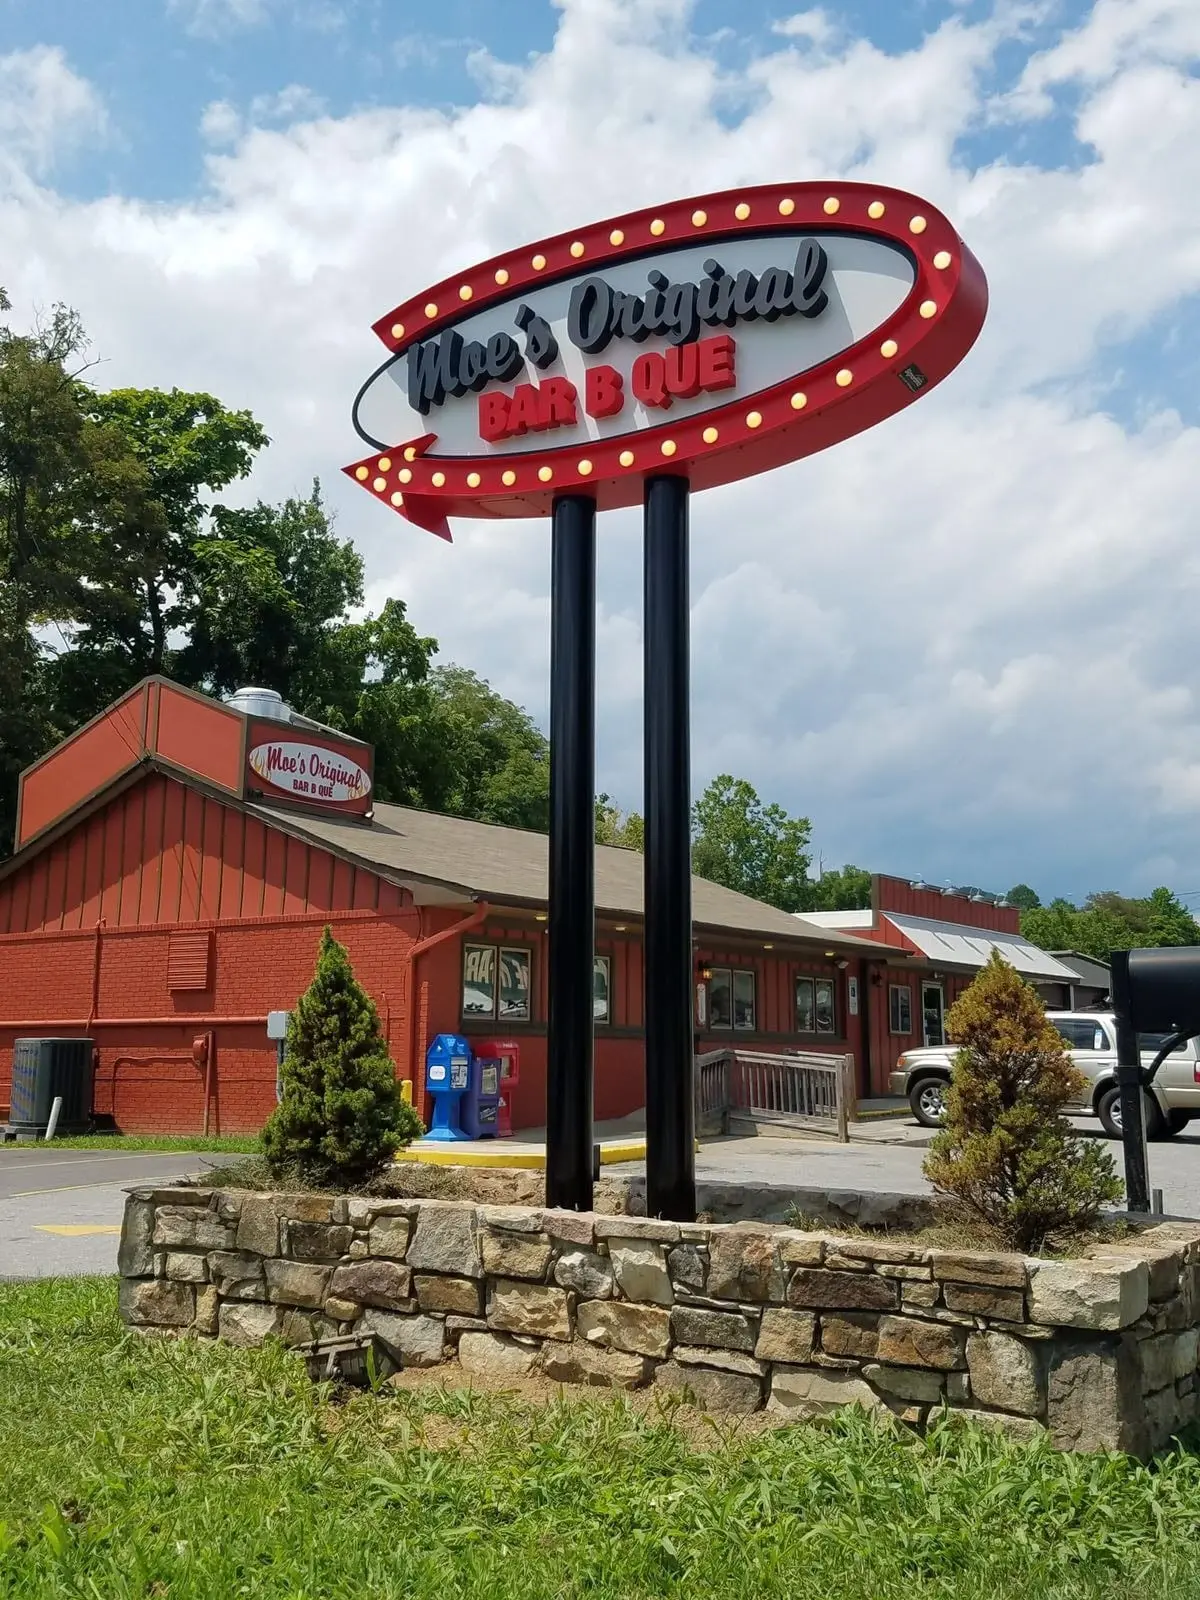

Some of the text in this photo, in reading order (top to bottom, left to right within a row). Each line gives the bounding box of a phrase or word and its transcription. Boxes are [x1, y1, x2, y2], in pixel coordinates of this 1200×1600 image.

[407, 238, 829, 416] Moe's Original
[479, 335, 736, 442] BAR B QUE
[267, 746, 362, 791] Moe's Original
[292, 779, 333, 798] BAR B QUE
